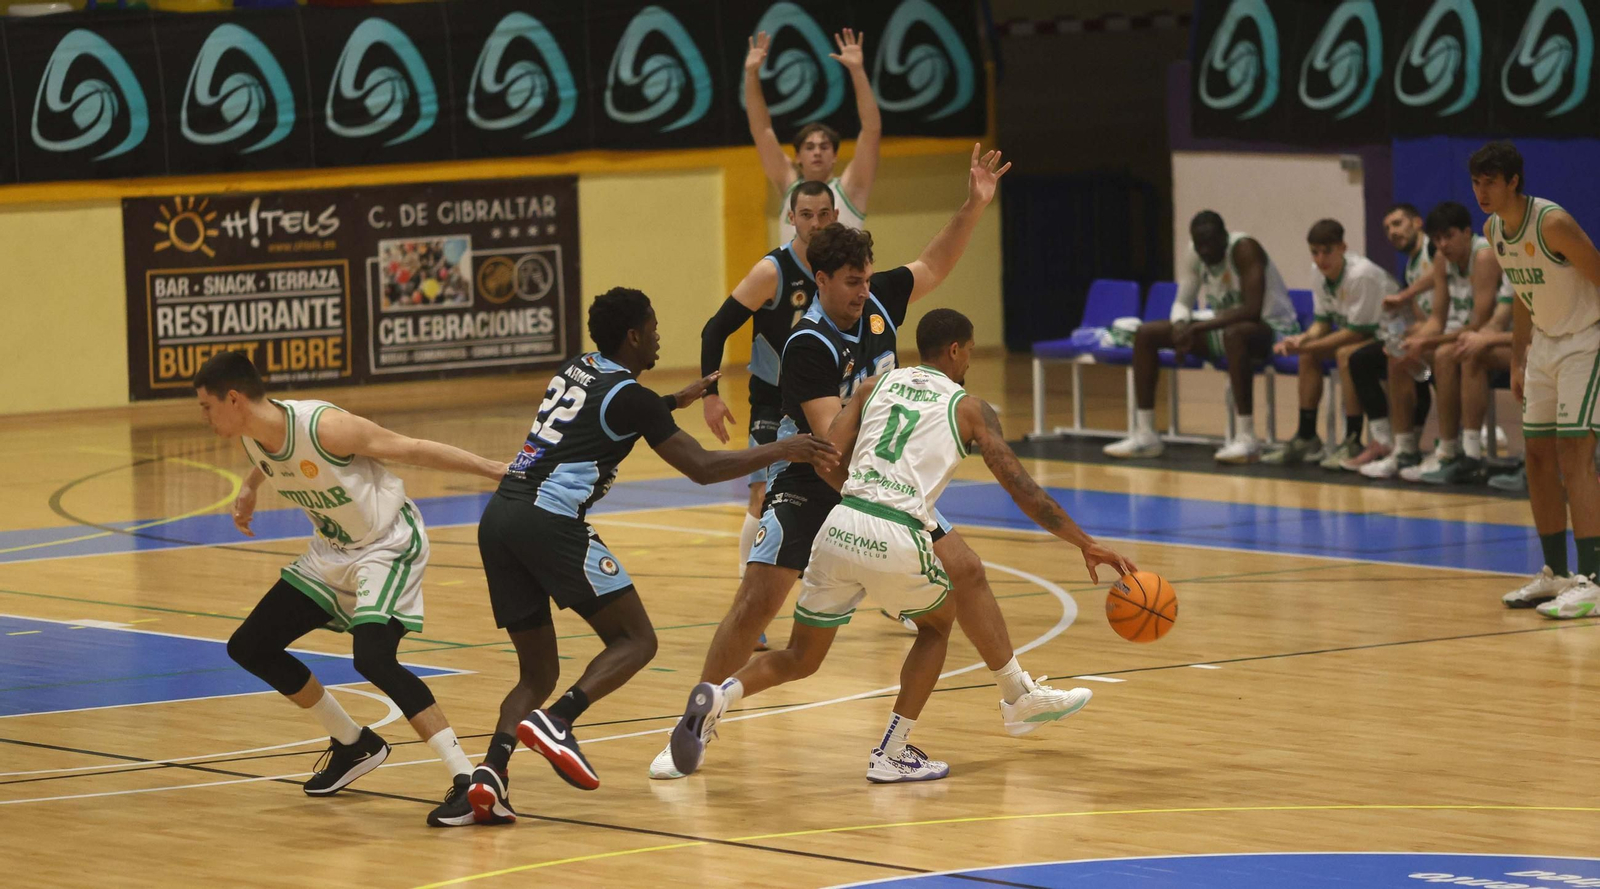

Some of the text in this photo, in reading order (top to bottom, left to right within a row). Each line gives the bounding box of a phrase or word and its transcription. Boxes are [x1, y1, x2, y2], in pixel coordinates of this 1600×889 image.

[368, 195, 556, 229] C. DE GIBRALTAR
[155, 268, 340, 298] BAR SNACK TERRAZA
[156, 297, 342, 338] RESTAURANTE
[379, 307, 555, 346] CELEBRACIONES
[266, 336, 342, 372] LIBRE
[531, 375, 587, 445] 22
[888, 382, 942, 403] PATRICK
[874, 403, 921, 464] 0
[828, 526, 888, 552] OKEYMAS
